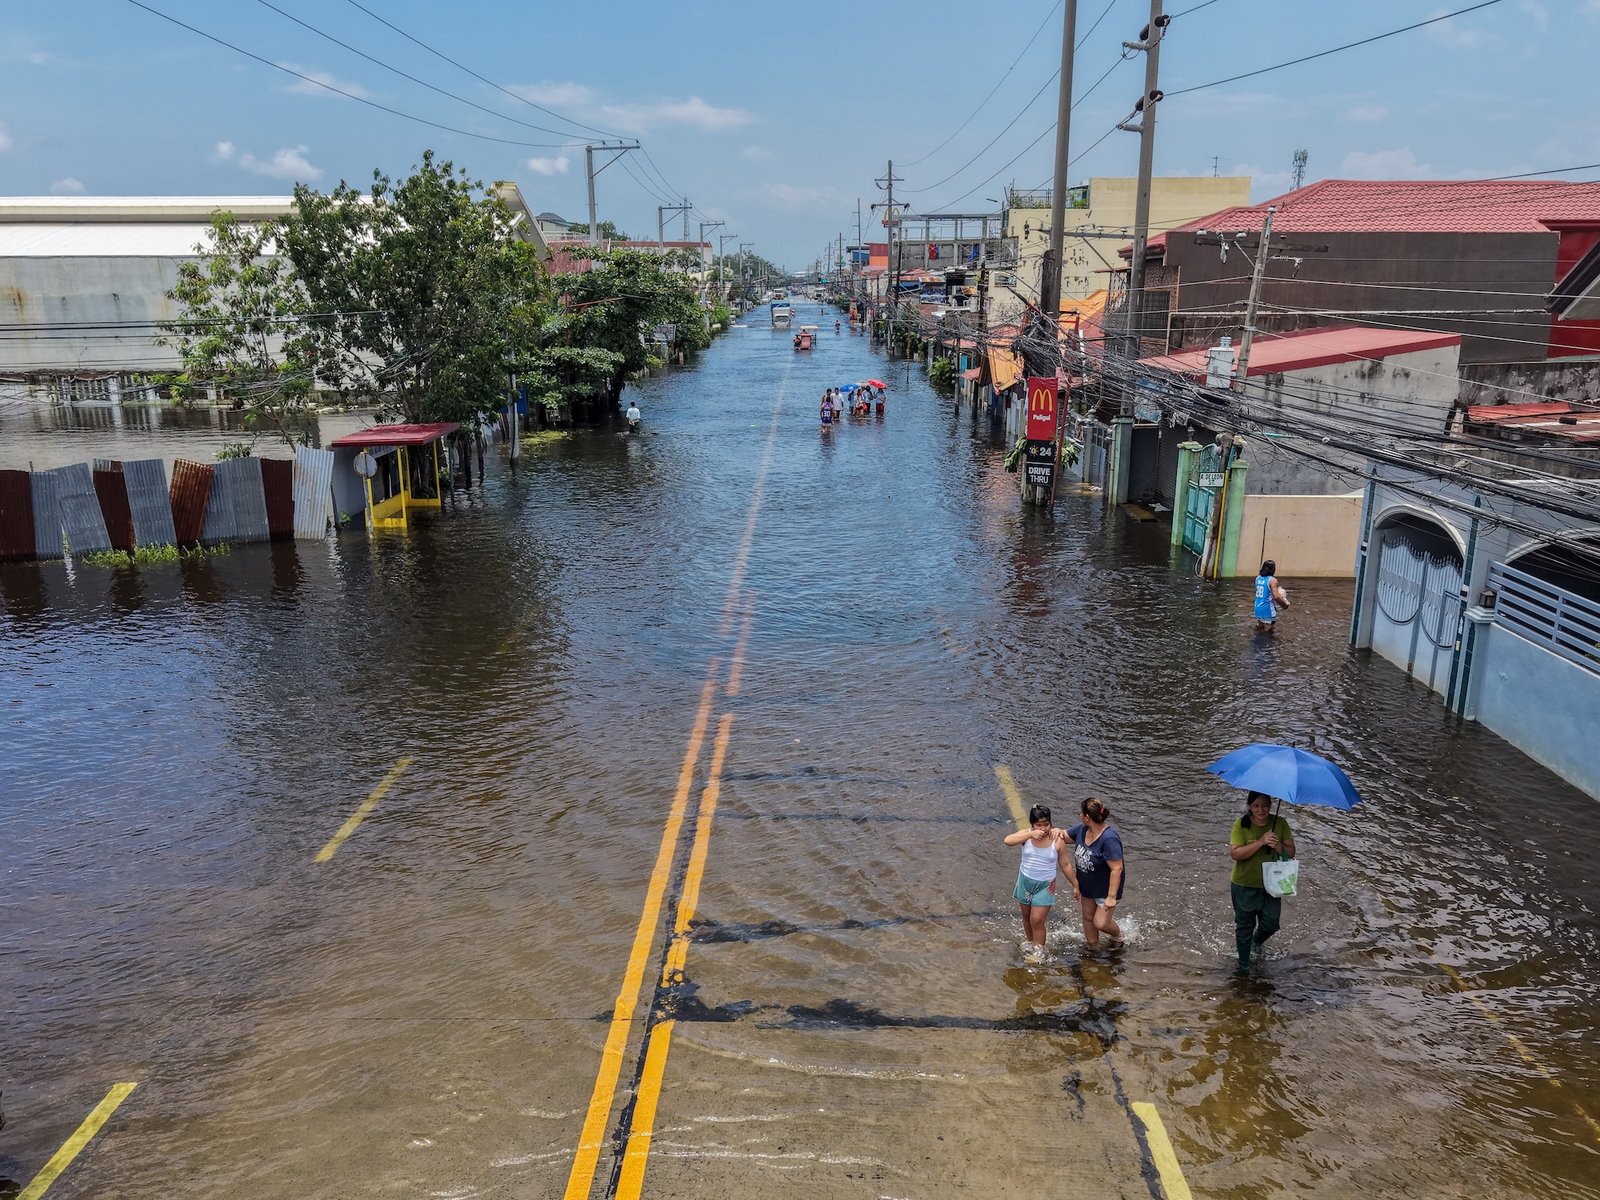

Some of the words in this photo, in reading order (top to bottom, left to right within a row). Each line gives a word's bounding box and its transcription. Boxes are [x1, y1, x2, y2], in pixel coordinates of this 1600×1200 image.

[1040, 447, 1051, 456] 24
[1028, 467, 1051, 476] DRIVE
[1030, 475, 1048, 484] THRU
